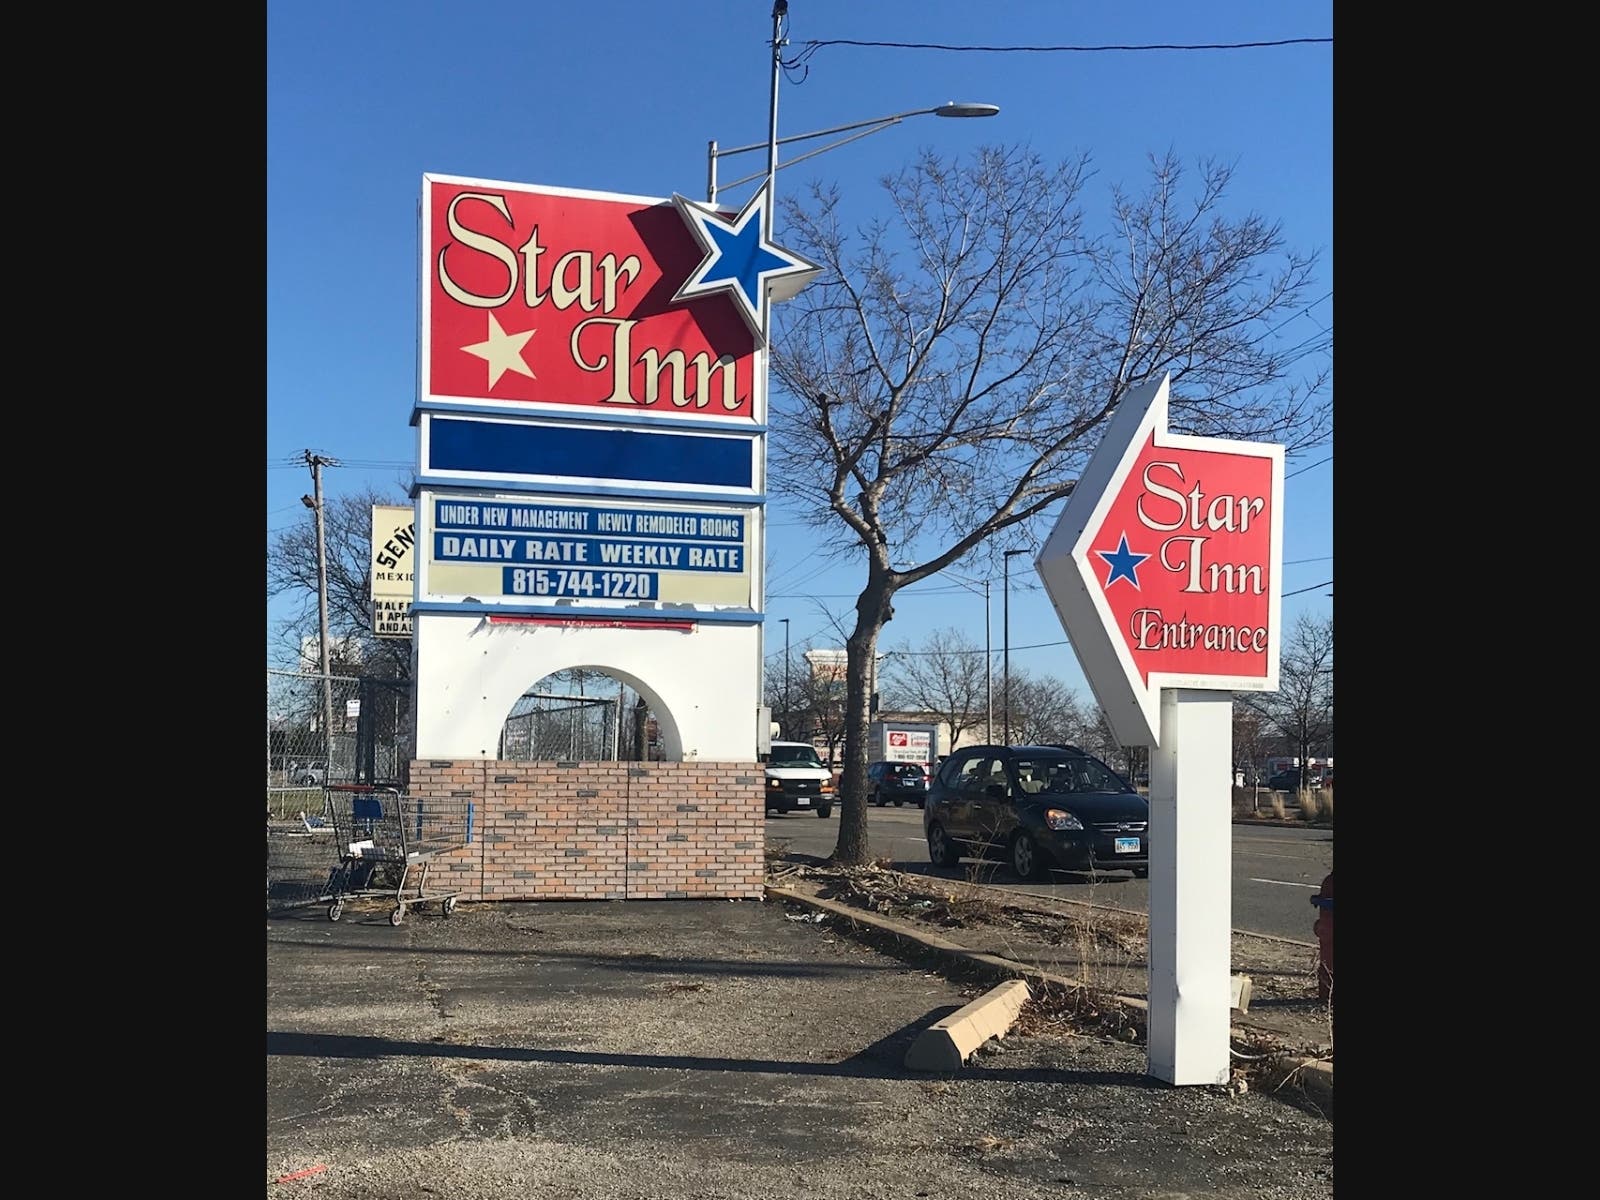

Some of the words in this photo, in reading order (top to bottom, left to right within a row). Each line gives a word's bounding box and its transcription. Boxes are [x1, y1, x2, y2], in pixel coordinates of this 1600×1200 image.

[438, 191, 642, 314] Star
[569, 317, 747, 411] Inn
[1136, 460, 1265, 533] Star
[440, 504, 479, 526] UNDER
[482, 507, 509, 526] NEW
[511, 508, 589, 530] MANAGEMENT
[597, 512, 633, 532] NEWLY
[636, 514, 697, 536] REMODELED
[700, 518, 739, 538] ROOMS
[442, 537, 516, 559] DAILY
[526, 540, 587, 562] RATE
[600, 544, 682, 566] WEEKLY
[688, 548, 739, 568] RATE
[1159, 536, 1266, 595] Inn
[513, 569, 650, 599] 815-744-1220
[377, 611, 413, 622] HAPP
[1130, 607, 1268, 652] Entrance
